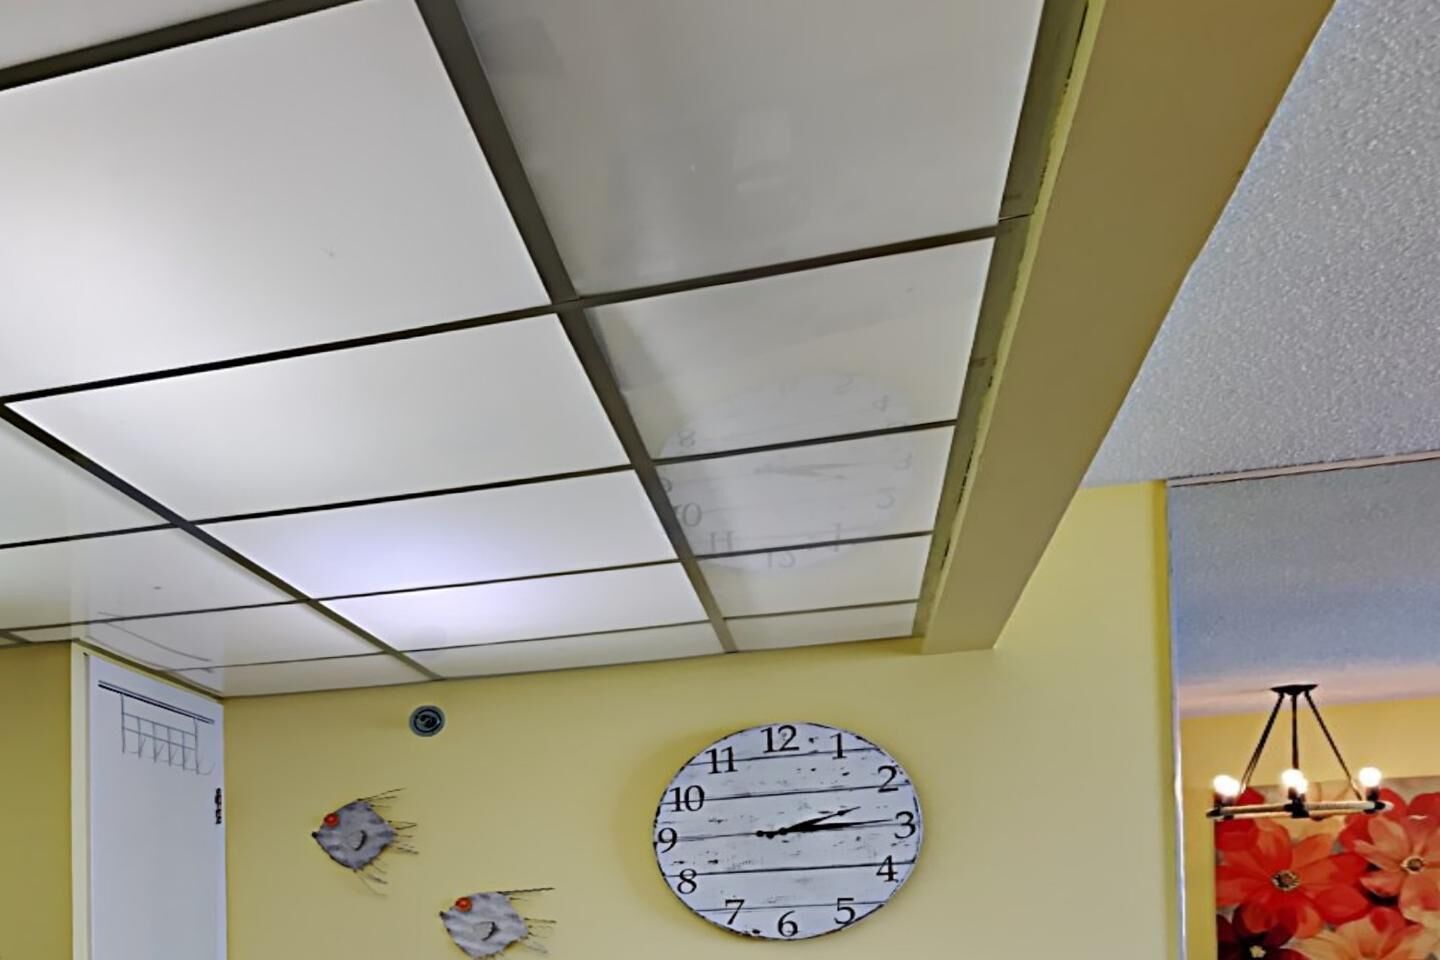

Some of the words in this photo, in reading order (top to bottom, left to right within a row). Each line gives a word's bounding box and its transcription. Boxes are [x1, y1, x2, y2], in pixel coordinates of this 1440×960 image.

[761, 724, 800, 753] 12
[831, 733, 847, 760] 1
[706, 746, 737, 774] 11
[877, 765, 900, 793] 2
[671, 785, 705, 812] 10
[895, 812, 916, 839] 3
[657, 827, 678, 853] 9
[677, 869, 698, 894] 8
[876, 855, 898, 882] 4
[725, 899, 745, 925] 7
[777, 911, 798, 937] 6
[834, 897, 856, 925] 5
